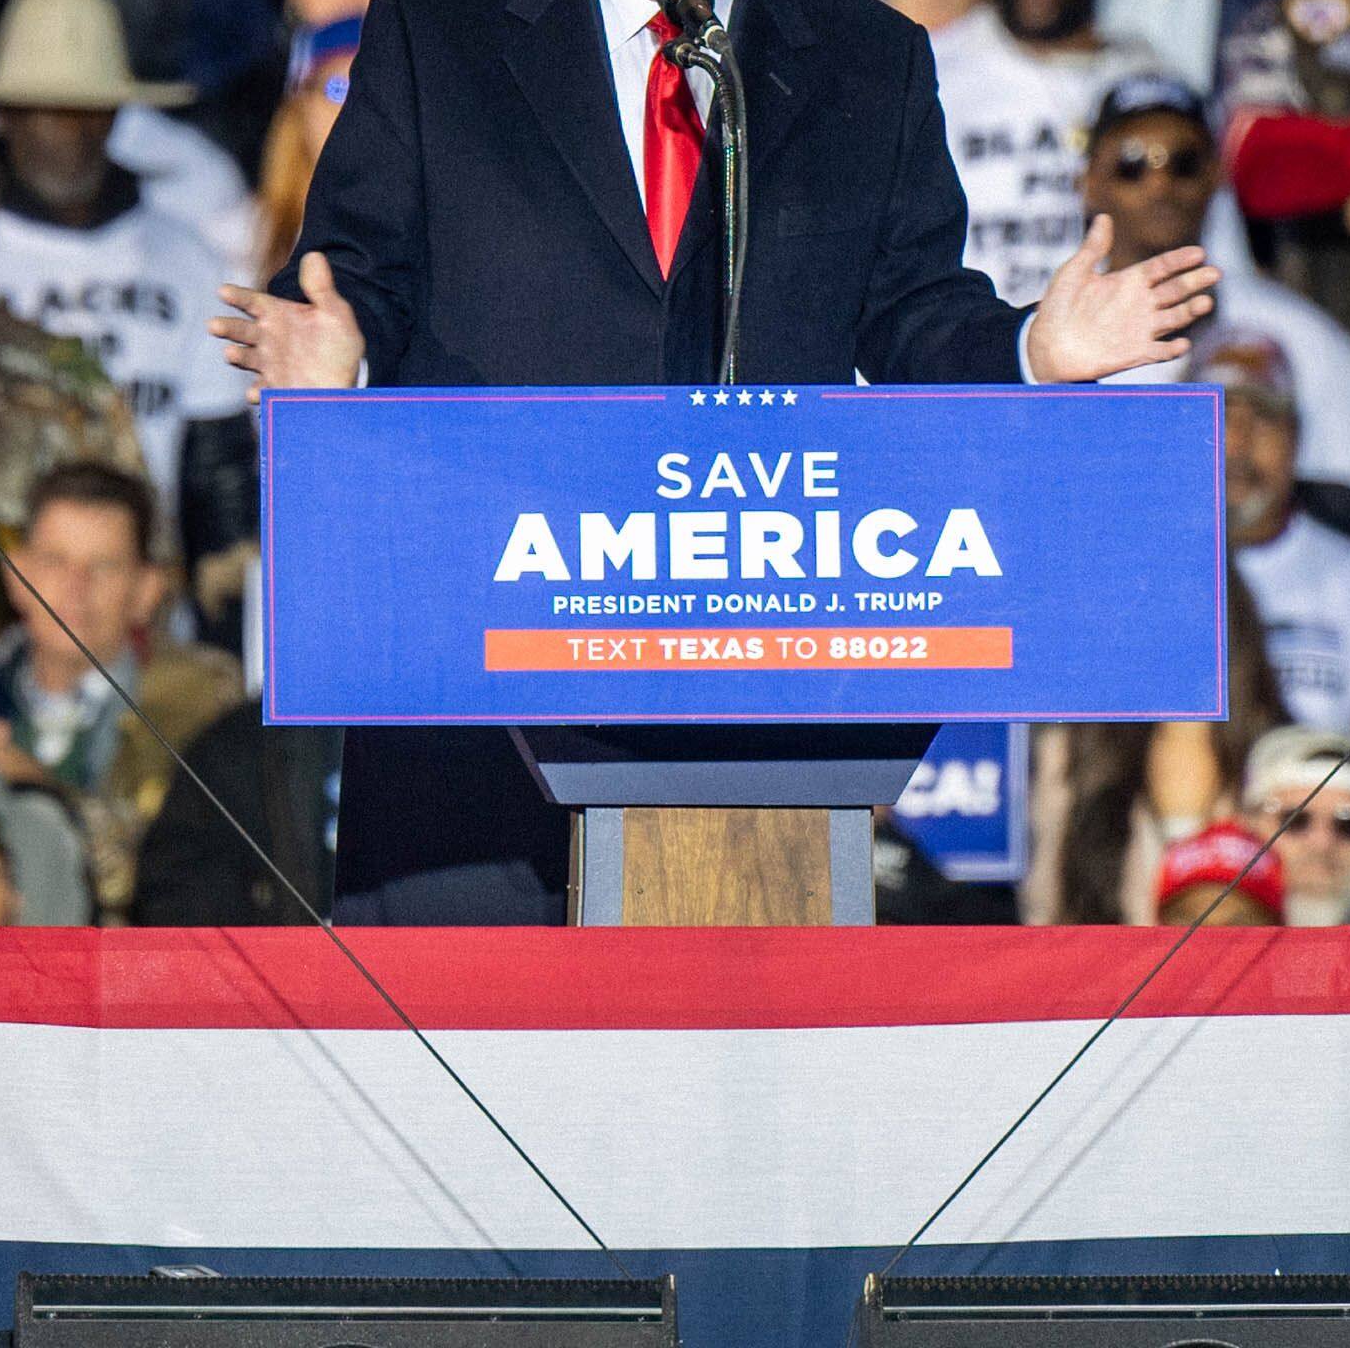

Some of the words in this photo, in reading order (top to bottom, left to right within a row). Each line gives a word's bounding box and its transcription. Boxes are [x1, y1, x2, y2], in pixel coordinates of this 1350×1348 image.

[656, 450, 840, 500] SAVE
[493, 508, 1003, 582] AMERICA
[553, 594, 696, 615] PRESIDENT
[706, 593, 816, 613] DONALD
[825, 592, 846, 612] J.
[854, 591, 943, 611] TRUMP
[567, 638, 647, 661] TEXT
[658, 637, 764, 660] TEXAS
[776, 637, 818, 659] TO
[829, 636, 928, 659] 88022
